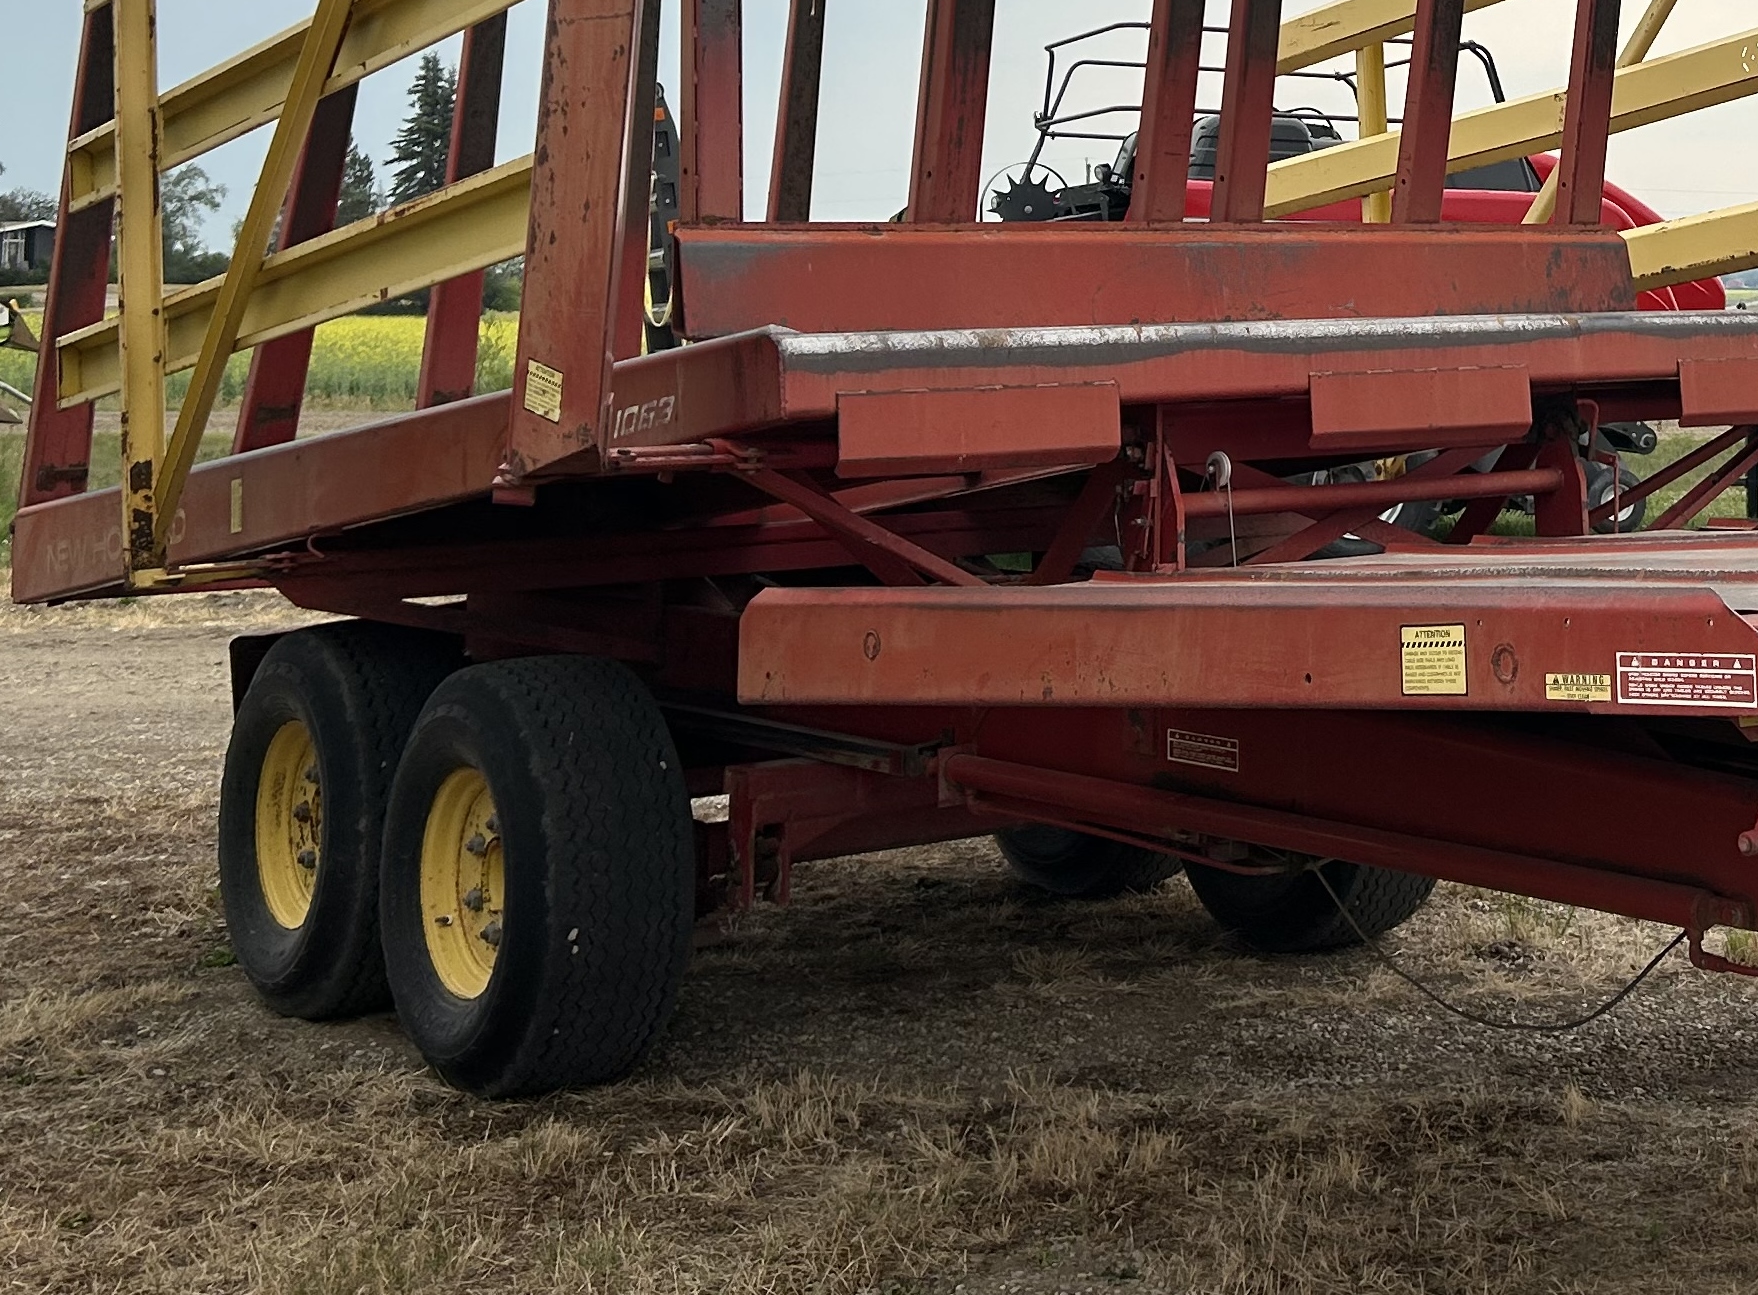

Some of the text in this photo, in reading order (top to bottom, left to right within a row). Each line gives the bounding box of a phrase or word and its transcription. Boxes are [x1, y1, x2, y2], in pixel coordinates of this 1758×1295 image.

[613, 395, 676, 439] 1063
[1415, 629, 1451, 639] ATTENTION
[1651, 658, 1721, 668] DANGER
[1561, 674, 1604, 686] WARNING
